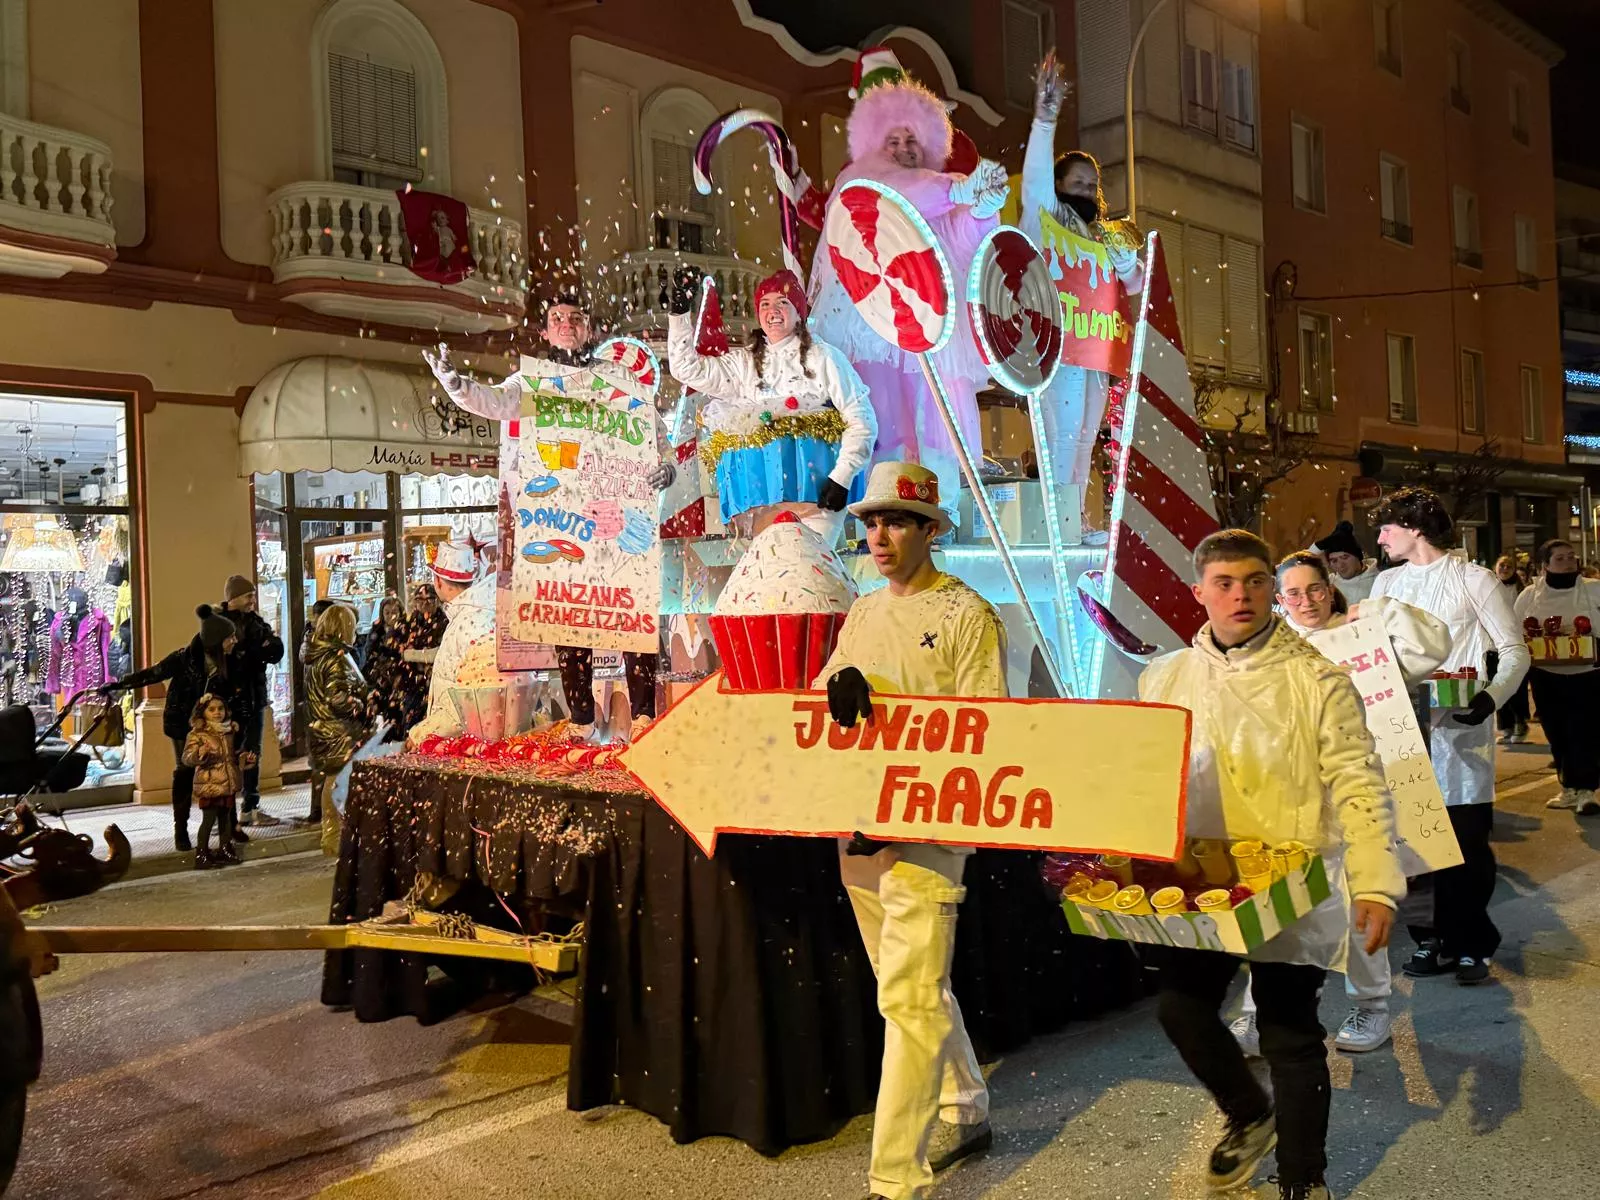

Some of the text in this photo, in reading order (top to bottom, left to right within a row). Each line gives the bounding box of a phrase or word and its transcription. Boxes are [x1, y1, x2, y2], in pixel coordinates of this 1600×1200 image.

[533, 394, 645, 445] BEBIDAS
[366, 445, 426, 466] María
[518, 508, 597, 542] DONUTS
[536, 580, 635, 610] MANZANAS
[519, 603, 656, 634] CARAMELIZADAS
